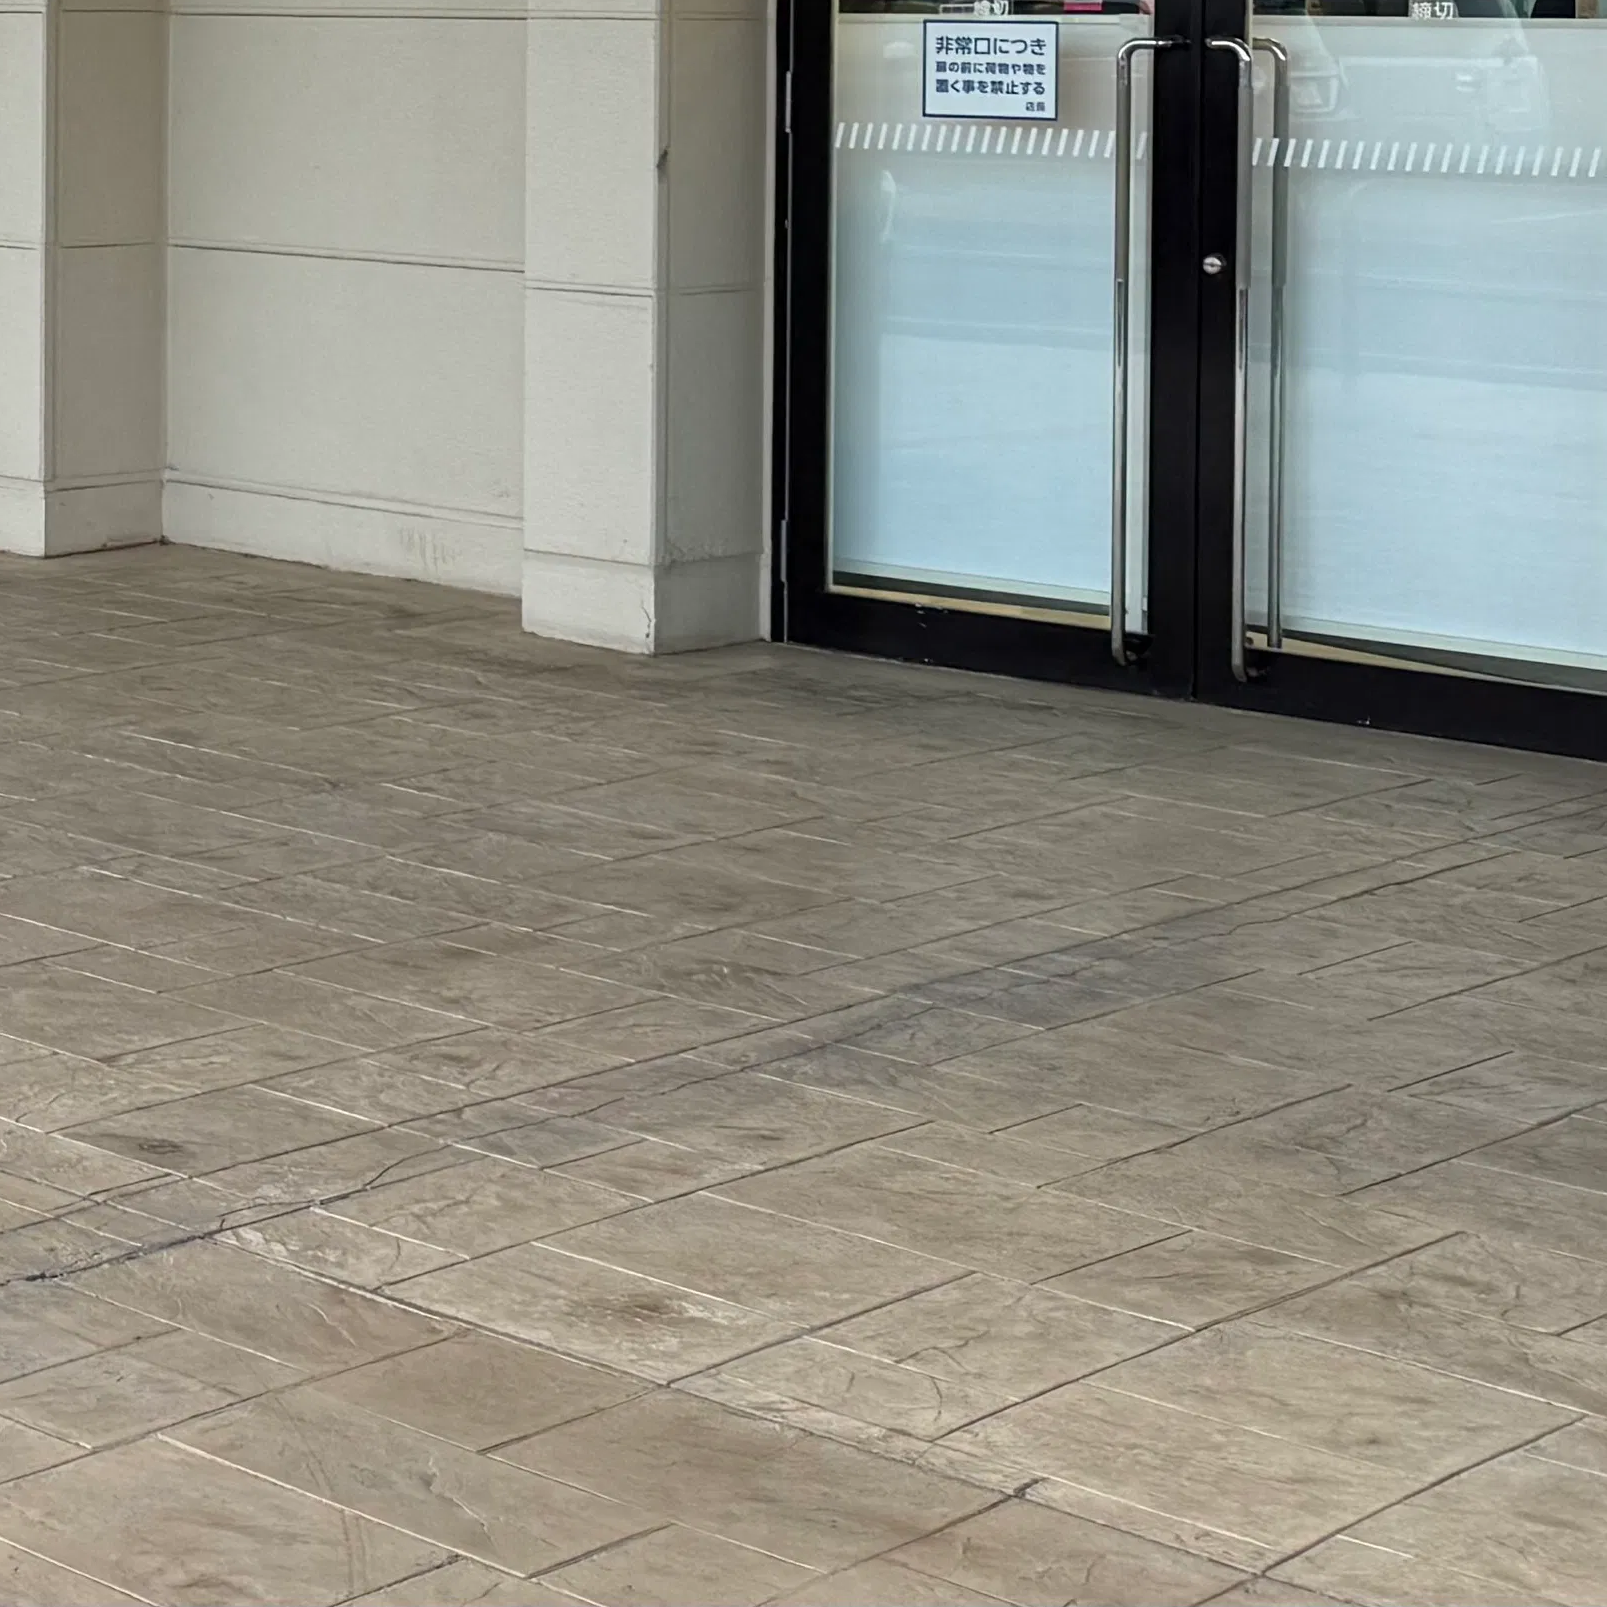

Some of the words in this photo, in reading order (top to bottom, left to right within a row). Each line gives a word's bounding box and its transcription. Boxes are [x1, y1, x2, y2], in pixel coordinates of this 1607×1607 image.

[936, 37, 1046, 56] 非常口につき
